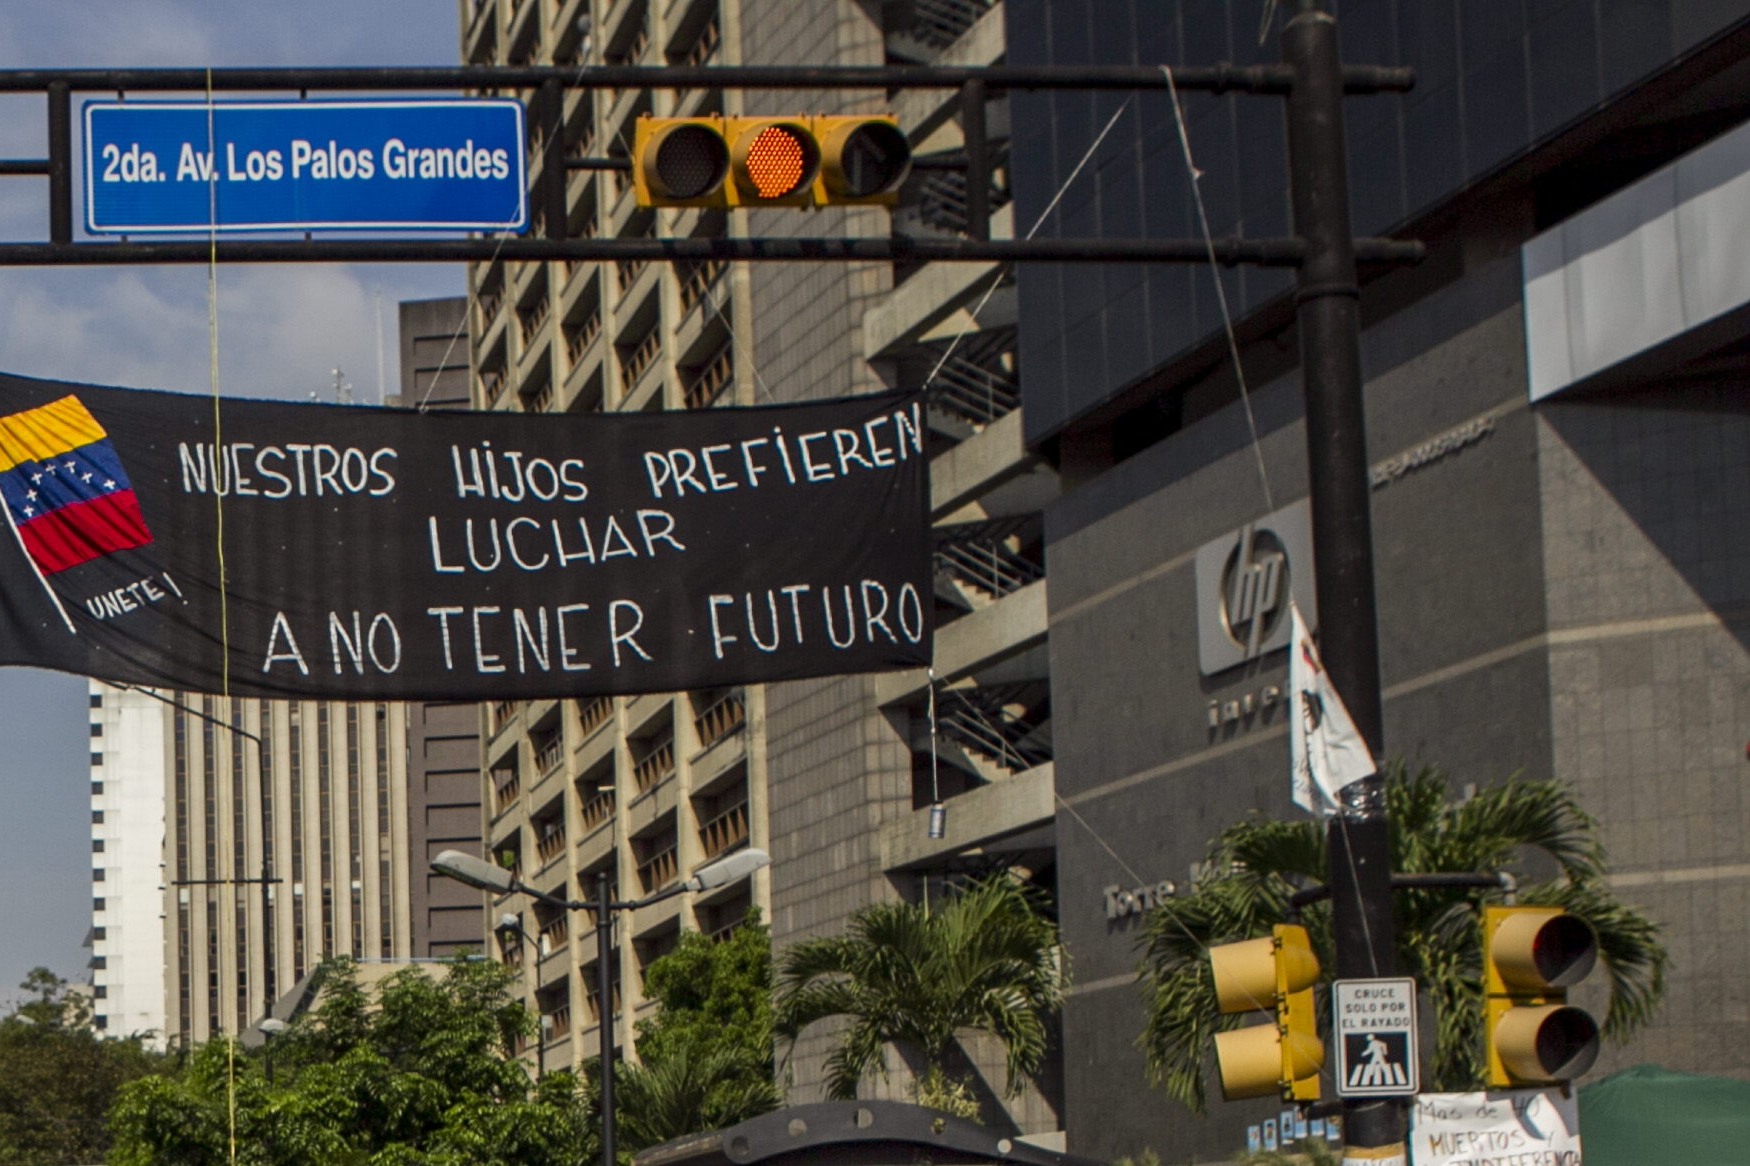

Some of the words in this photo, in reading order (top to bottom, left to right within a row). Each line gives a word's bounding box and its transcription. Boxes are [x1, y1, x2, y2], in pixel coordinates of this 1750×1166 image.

[102, 143, 165, 182] 2da.
[177, 142, 219, 182] Av.
[227, 142, 283, 181] Los
[292, 139, 375, 180] Palos
[383, 138, 509, 180] Grandes
[179, 442, 398, 498] NUESTROS
[644, 401, 923, 499] PREFIEREN
[428, 509, 686, 573] LUCHAR
[263, 611, 309, 675] A
[329, 610, 402, 675] NO
[708, 579, 924, 660] FUTURO
[1346, 1003, 1377, 1013] SOLO
[1381, 1002, 1405, 1012] POR
[1355, 989, 1395, 998] CRUCE
[1342, 1019, 1355, 1028] EL
[1361, 1017, 1410, 1027] RAYADO
[1429, 1130, 1526, 1156] MUERTOS
